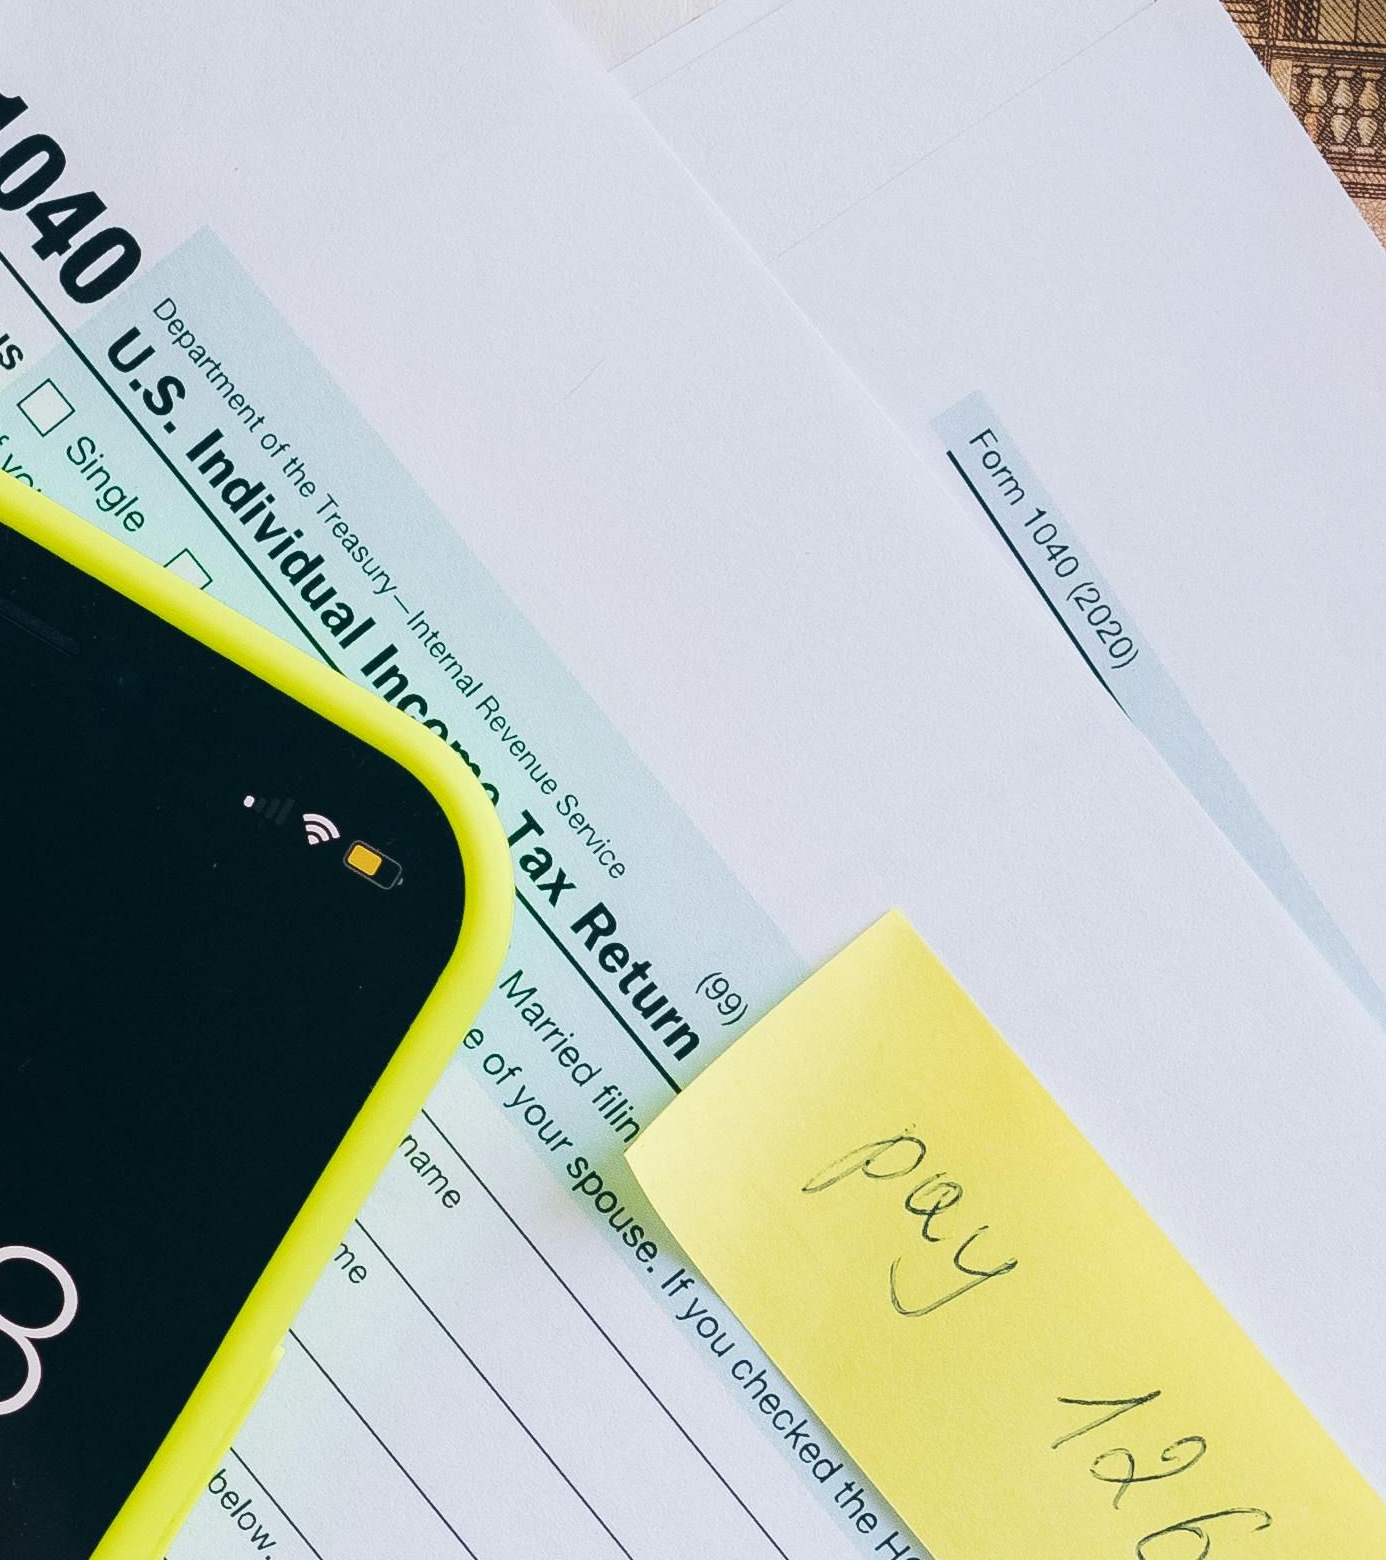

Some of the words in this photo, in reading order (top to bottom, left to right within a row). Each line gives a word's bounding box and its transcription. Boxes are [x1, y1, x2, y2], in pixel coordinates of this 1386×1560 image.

[106, 325, 187, 435] U.S.
[151, 296, 266, 434] Department
[65, 435, 146, 533] Single
[184, 427, 377, 651] Individual
[968, 427, 1026, 507] Form
[1023, 506, 1080, 579] 1040
[1065, 580, 1140, 671] (2020)
[259, 432, 292, 459] of
[281, 456, 317, 499] the
[474, 694, 559, 796] Revenue
[555, 793, 627, 880] Service
[694, 970, 749, 1027] (99)
[506, 808, 578, 909] Tax
[569, 901, 701, 1063] Return
[482, 1052, 524, 1086] of
[497, 968, 604, 1088] Married
[502, 1084, 574, 1152] your
[565, 1155, 659, 1274] spouse.
[800, 1134, 1019, 1318] pay
[660, 1267, 696, 1298] If
[674, 1296, 736, 1359] you
[730, 1358, 845, 1485] checked
[833, 1480, 879, 1535] the
